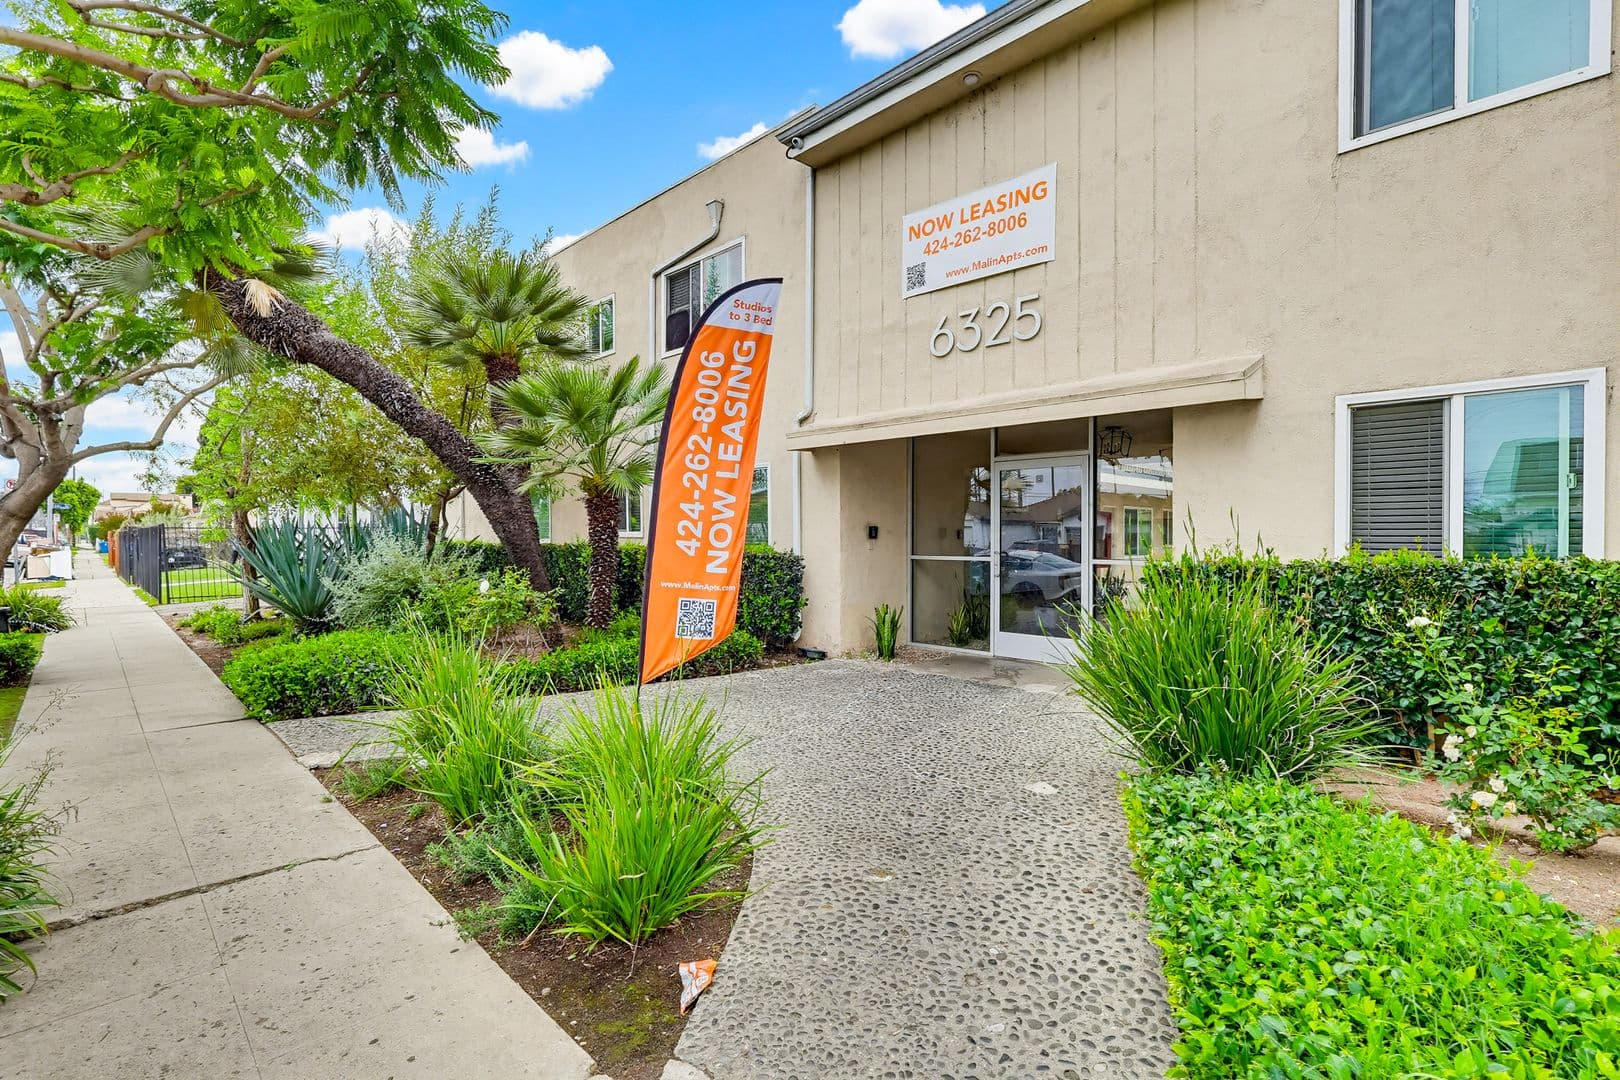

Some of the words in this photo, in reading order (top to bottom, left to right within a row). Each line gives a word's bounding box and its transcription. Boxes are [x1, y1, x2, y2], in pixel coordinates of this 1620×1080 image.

[908, 212, 954, 242] NOW
[960, 181, 1048, 225] LEASING
[923, 212, 1028, 256] 424-262-8006
[945, 245, 1048, 278] www.MalinApts.com
[729, 311, 741, 320] to
[744, 312, 751, 322] 3
[753, 314, 773, 326] Bed
[733, 299, 772, 313] Studios
[930, 293, 1043, 358] 6325
[716, 340, 757, 480] LEASING
[675, 351, 725, 557] 424-262-8006
[706, 488, 737, 575] NOW
